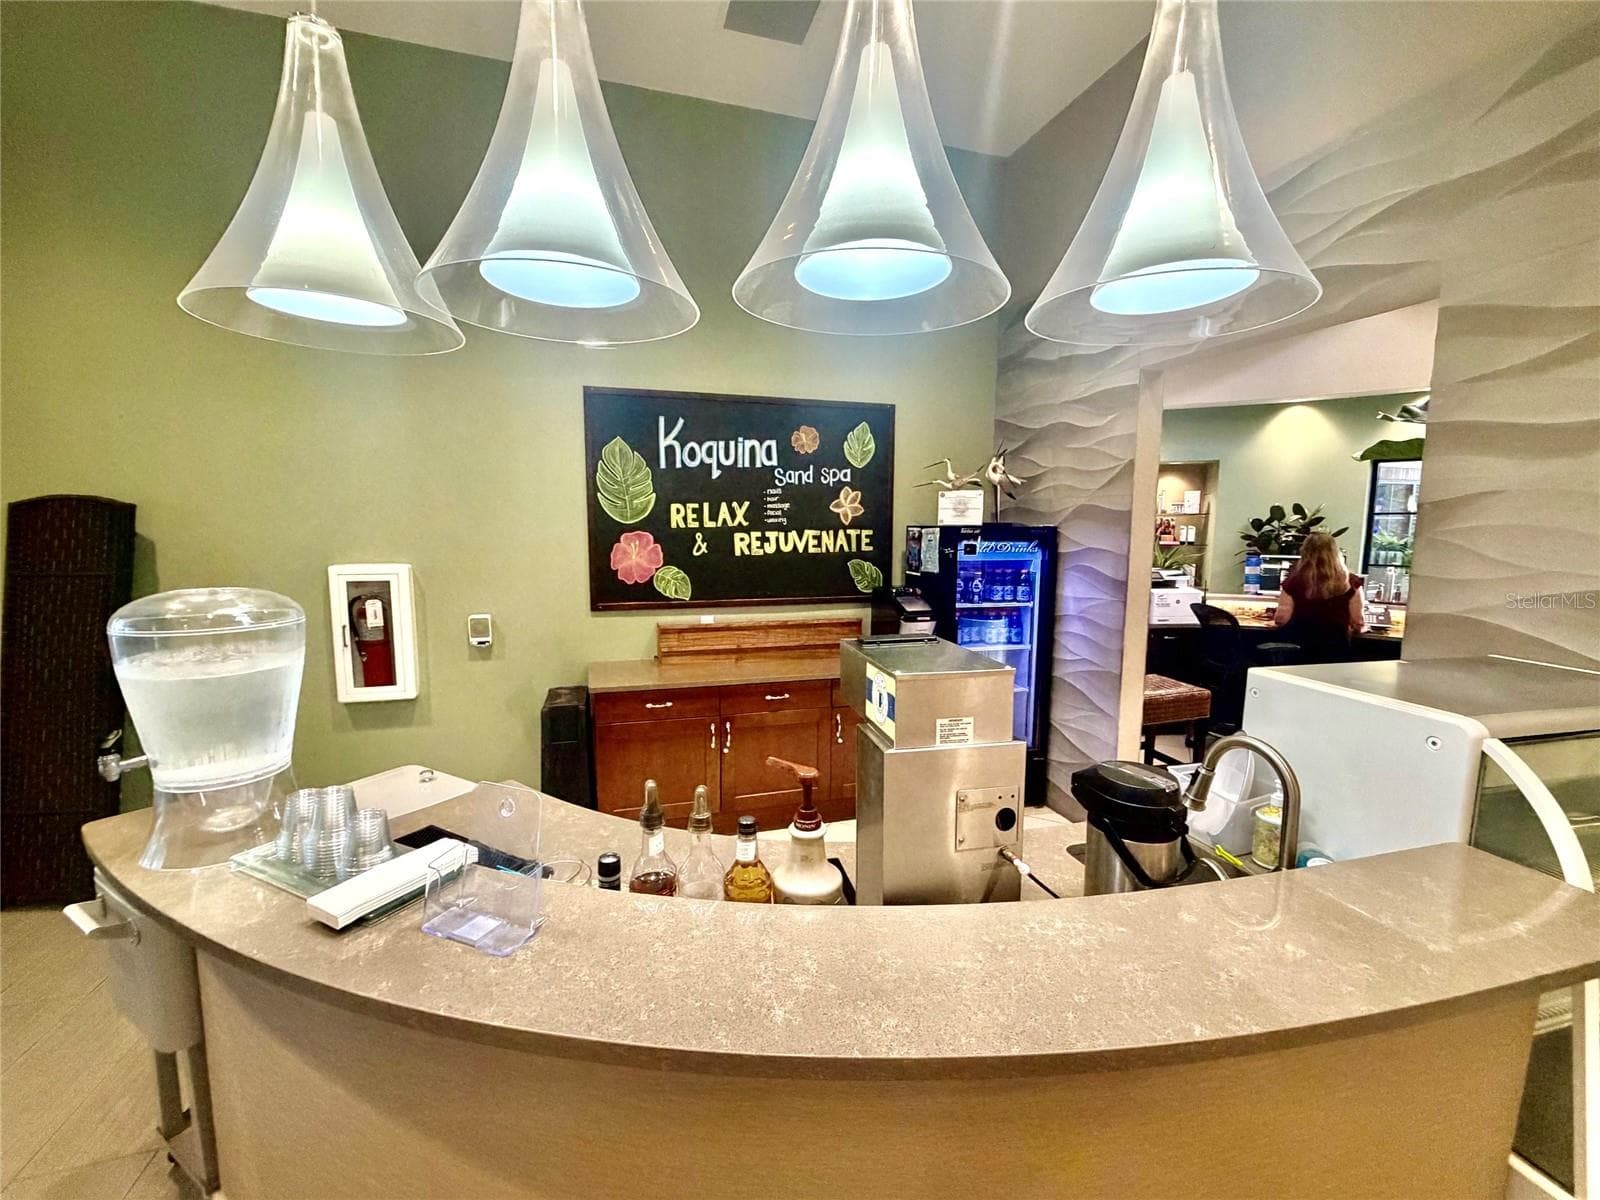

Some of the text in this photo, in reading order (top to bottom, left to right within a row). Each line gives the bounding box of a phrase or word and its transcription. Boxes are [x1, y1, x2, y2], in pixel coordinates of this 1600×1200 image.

[658, 415, 778, 480] Koquina
[774, 464, 814, 487] Sand
[670, 501, 750, 529] RELAX
[692, 529, 874, 557] & REJUVENATE
[996, 540, 1039, 553] Drinks
